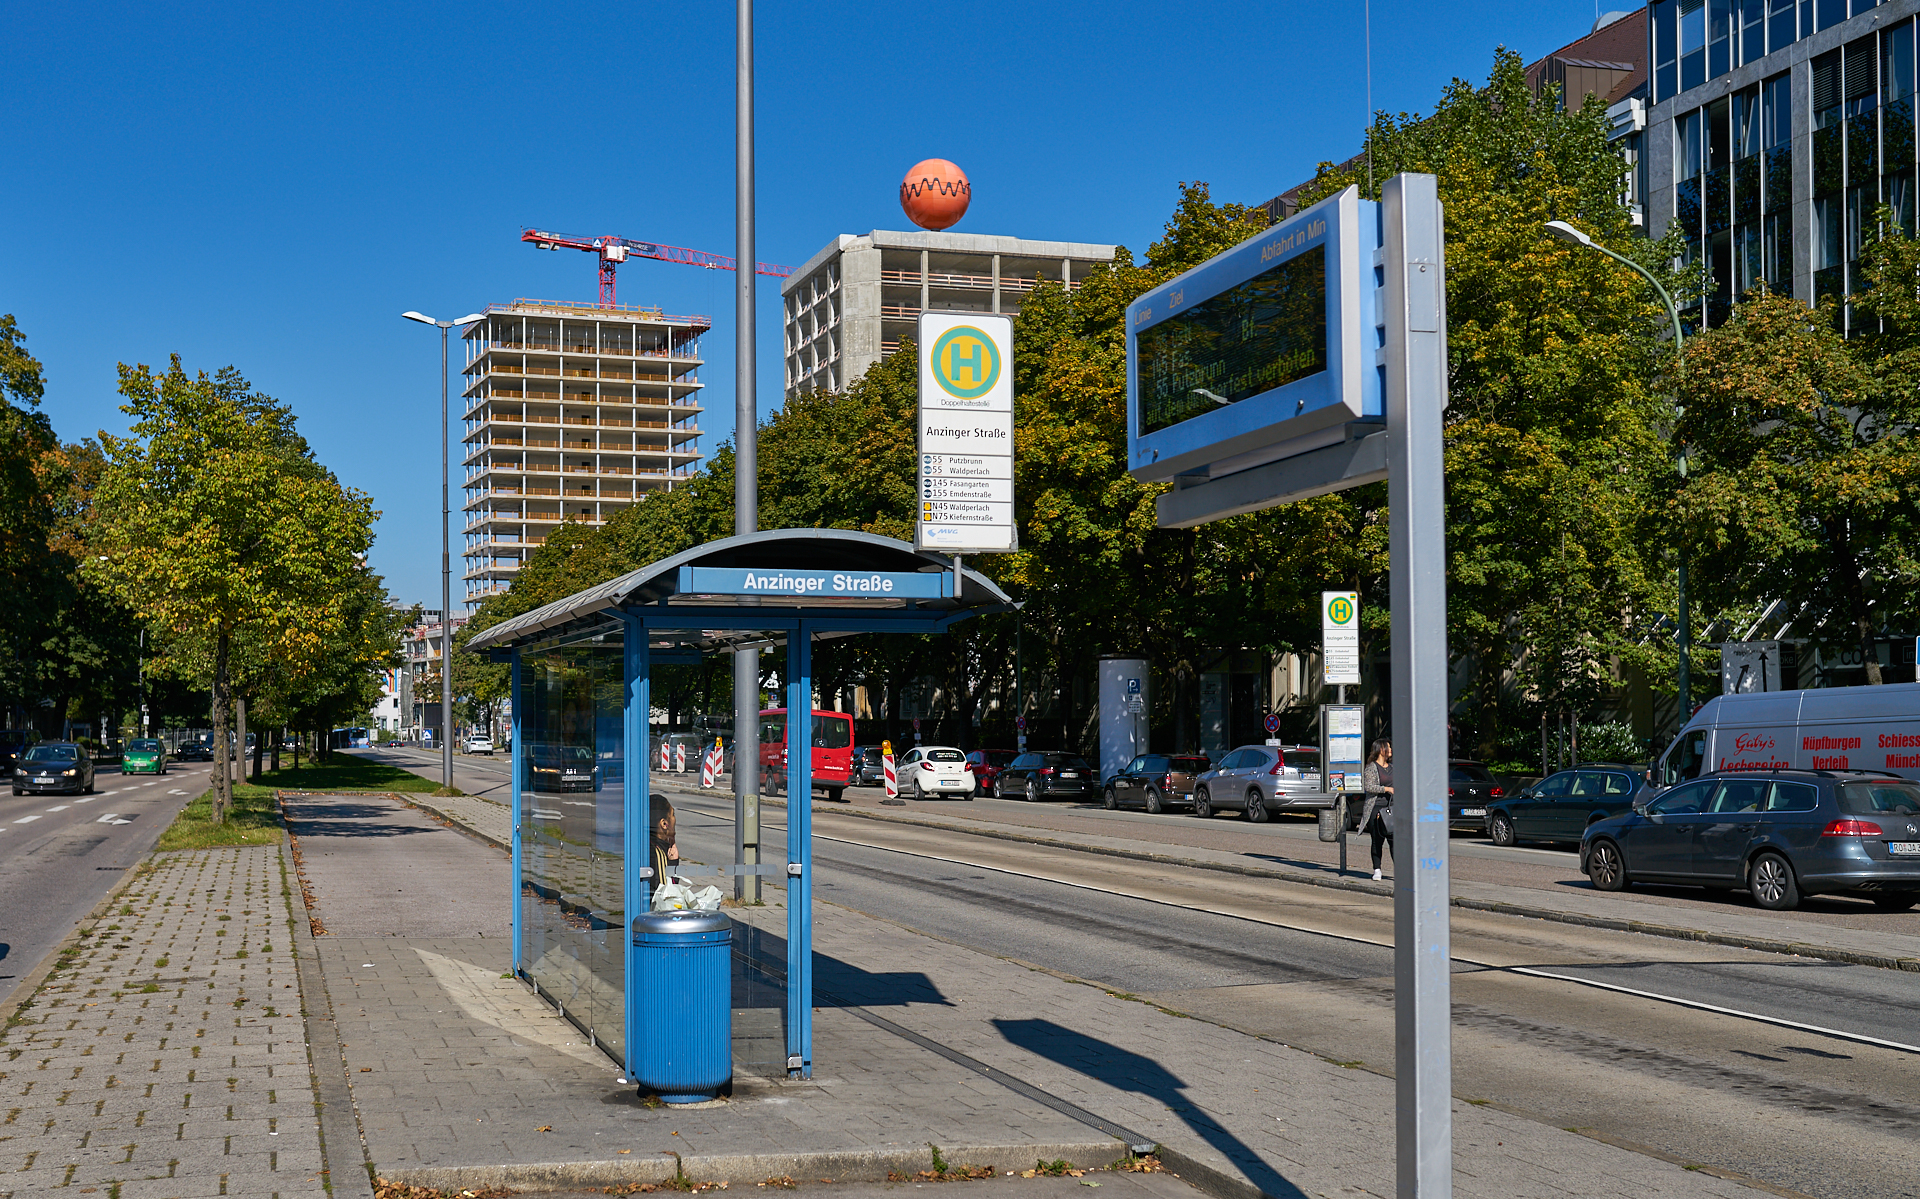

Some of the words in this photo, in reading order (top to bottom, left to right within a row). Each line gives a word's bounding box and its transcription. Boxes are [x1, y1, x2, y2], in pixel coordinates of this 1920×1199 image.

[1134, 306, 1152, 326] Linie
[1169, 289, 1184, 309] Ziel
[1261, 233, 1294, 264] Abfahrt
[1296, 229, 1305, 246] in
[1307, 219, 1326, 240] Min
[941, 399, 990, 407] Doppelhaltestelle
[926, 426, 971, 439] Anzinger
[974, 427, 1006, 438] Straße
[932, 455, 943, 463] 55
[949, 457, 983, 465] Putzbrunn
[932, 465, 943, 474] 55
[949, 467, 990, 475] Waldperlach
[932, 479, 948, 487] 145
[949, 480, 990, 489] Fasangarten
[932, 489, 948, 497] 155
[949, 490, 992, 498] Emdenstraße
[932, 502, 948, 510] N45
[949, 504, 990, 512] Waldperlach
[932, 513, 948, 521] N75
[949, 514, 993, 522] Kiefernstraße
[743, 573, 825, 593] Anzinger
[832, 574, 893, 592] Straße
[1802, 737, 1861, 751] Hüpfburgen
[1813, 756, 1849, 769] Verleih
